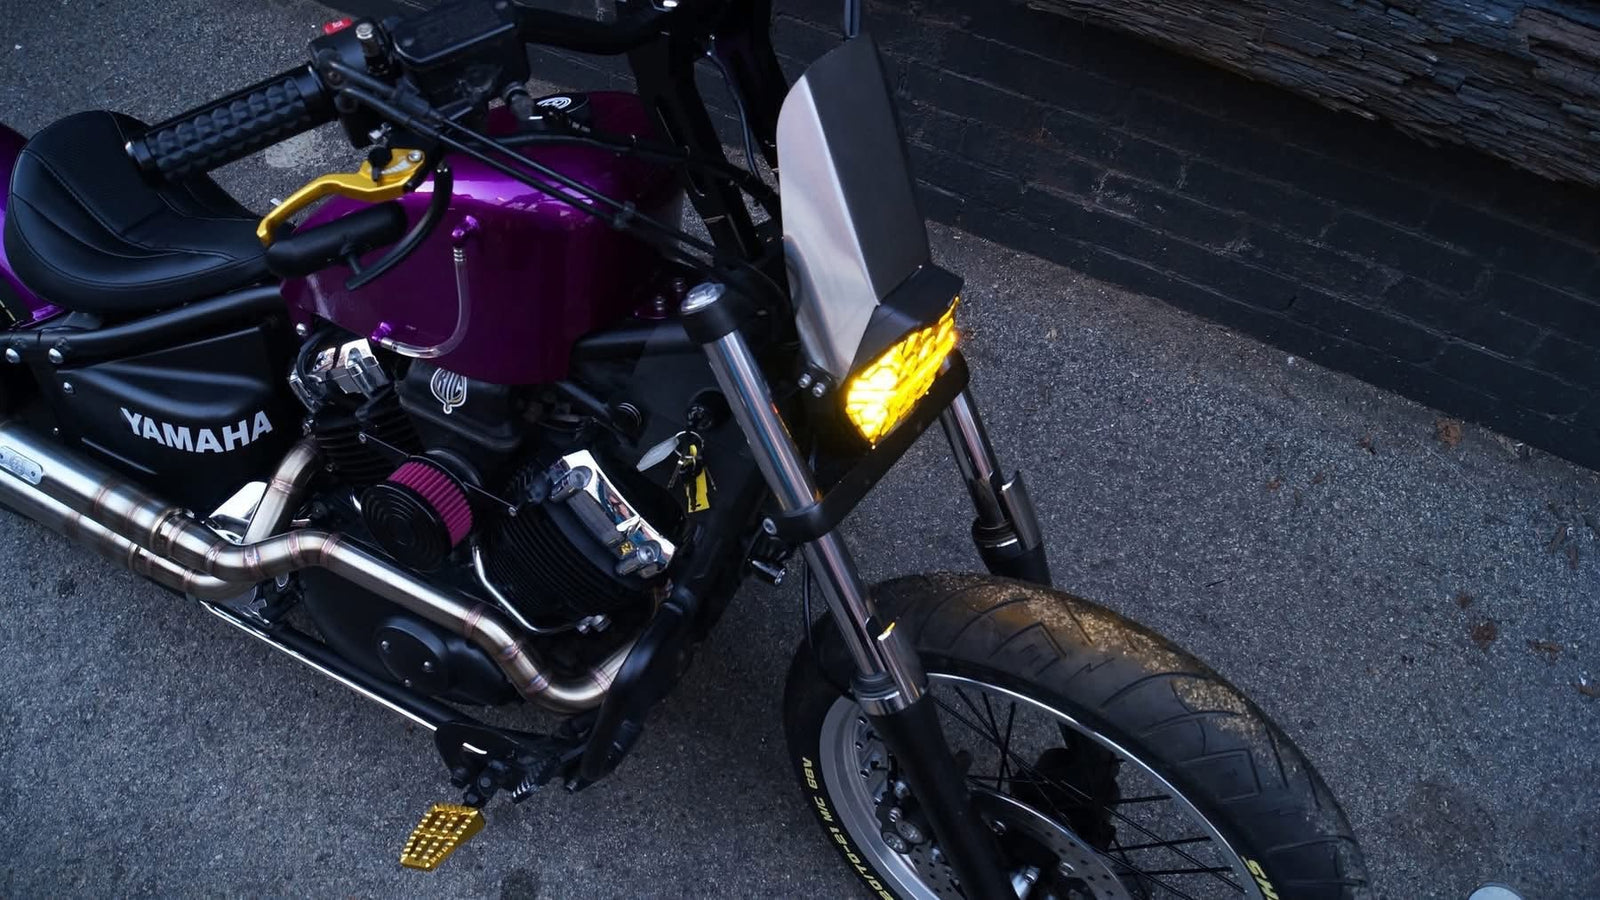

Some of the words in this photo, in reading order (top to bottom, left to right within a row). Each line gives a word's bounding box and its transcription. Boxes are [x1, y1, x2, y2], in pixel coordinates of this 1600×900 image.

[120, 407, 274, 454] YAMAHA
[813, 796, 833, 822] M/C
[1241, 855, 1280, 900] SH
